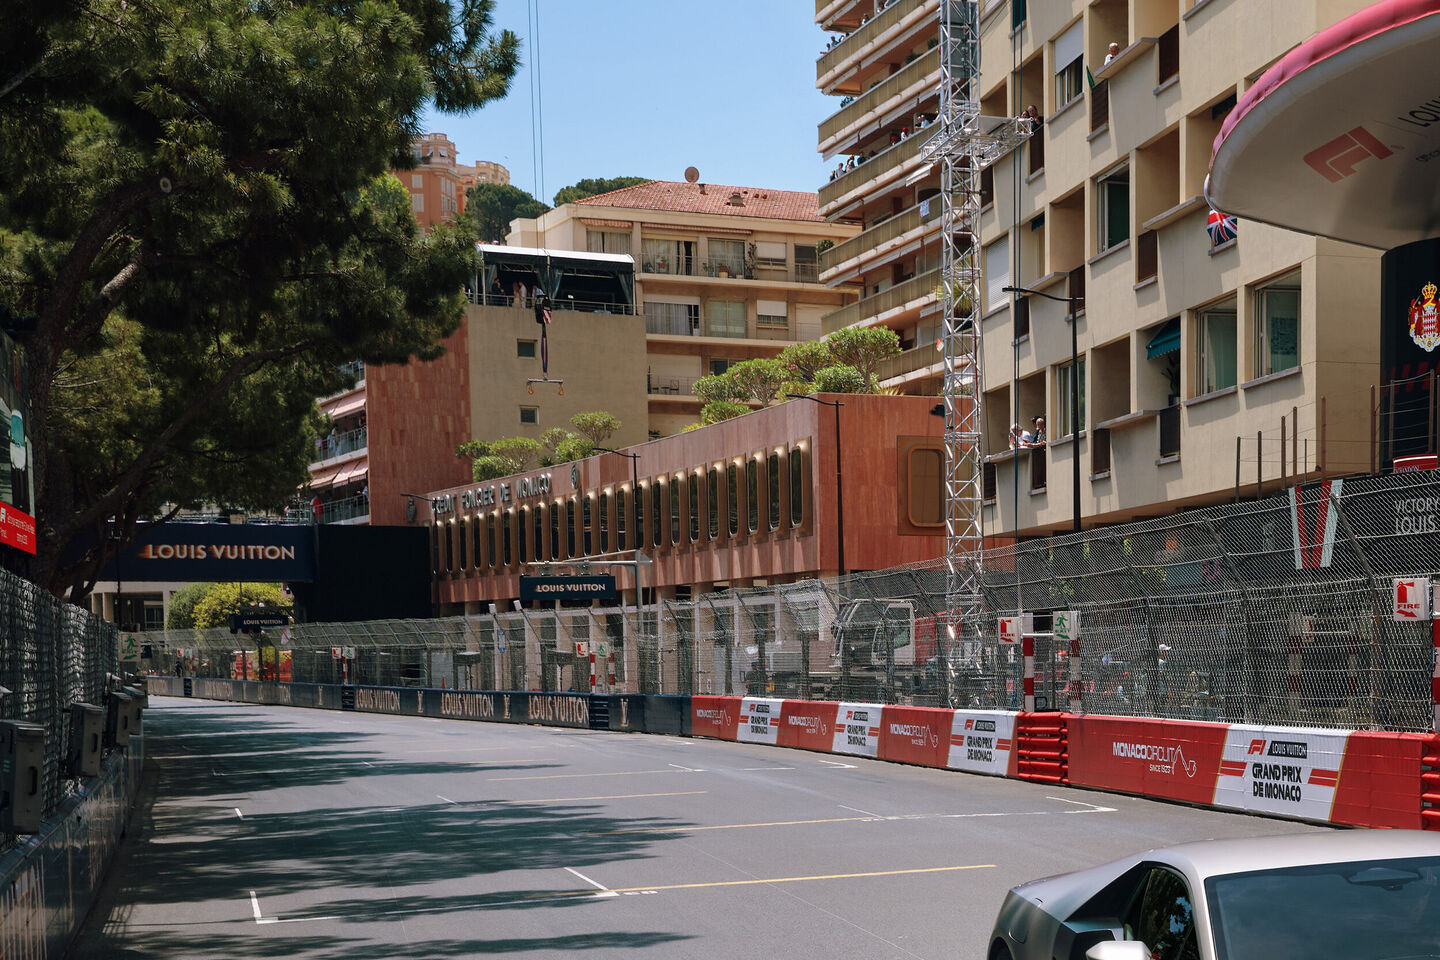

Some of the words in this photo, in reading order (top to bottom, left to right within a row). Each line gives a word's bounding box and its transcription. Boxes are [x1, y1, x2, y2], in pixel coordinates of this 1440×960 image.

[461, 485, 495, 508] FONCIER
[500, 481, 511, 502] DE
[515, 472, 552, 499] MONACO
[1394, 498, 1439, 513] VICTORY
[1395, 514, 1436, 534] LOUIS
[148, 544, 207, 560] LOUIS
[212, 545, 295, 560] VUITTON
[536, 584, 565, 593] LOUIS
[566, 583, 606, 592] VUITTON
[356, 688, 374, 709] LOUIS
[441, 693, 462, 716] LOUIS
[463, 693, 494, 717] VUITTON
[528, 695, 553, 721] LOUIS
[554, 695, 589, 723] VUITTON
[967, 735, 981, 748] GRAND
[981, 736, 993, 749] PRIX
[1272, 743, 1286, 754] LOUIS
[1287, 744, 1306, 756] VUITTON
[967, 748, 973, 760] DE
[974, 749, 992, 762] MONACO
[1252, 763, 1280, 780] GRAND
[1282, 765, 1302, 783] PRIX
[1253, 781, 1264, 797] DE
[1265, 782, 1301, 802] MONACO
